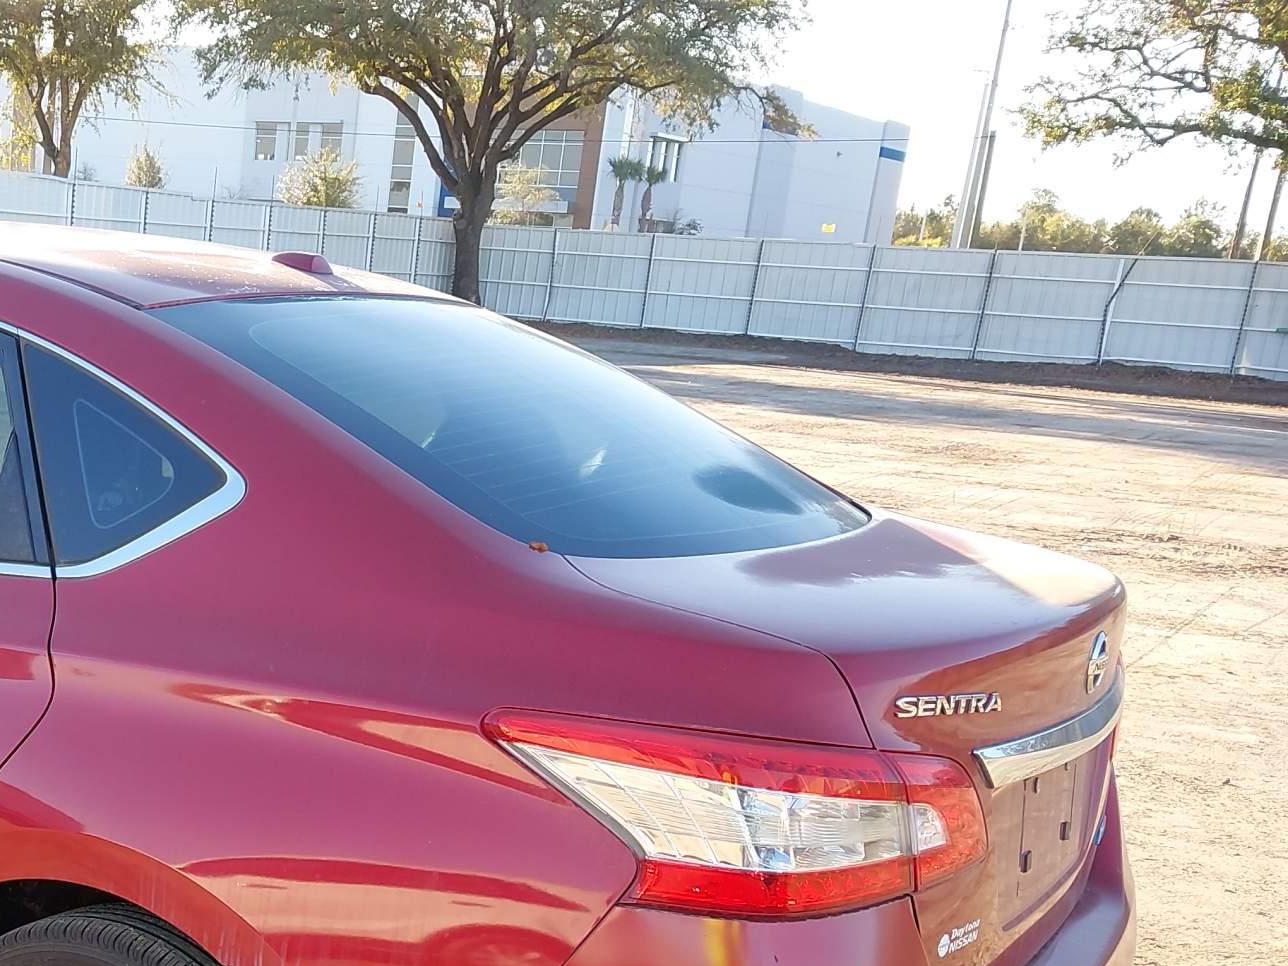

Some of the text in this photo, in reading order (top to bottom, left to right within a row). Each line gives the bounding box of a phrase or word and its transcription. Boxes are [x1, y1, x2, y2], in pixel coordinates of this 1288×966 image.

[893, 692, 1002, 718] SENTRA
[948, 929, 979, 954] NISSAN
[951, 918, 981, 941] Daytona
